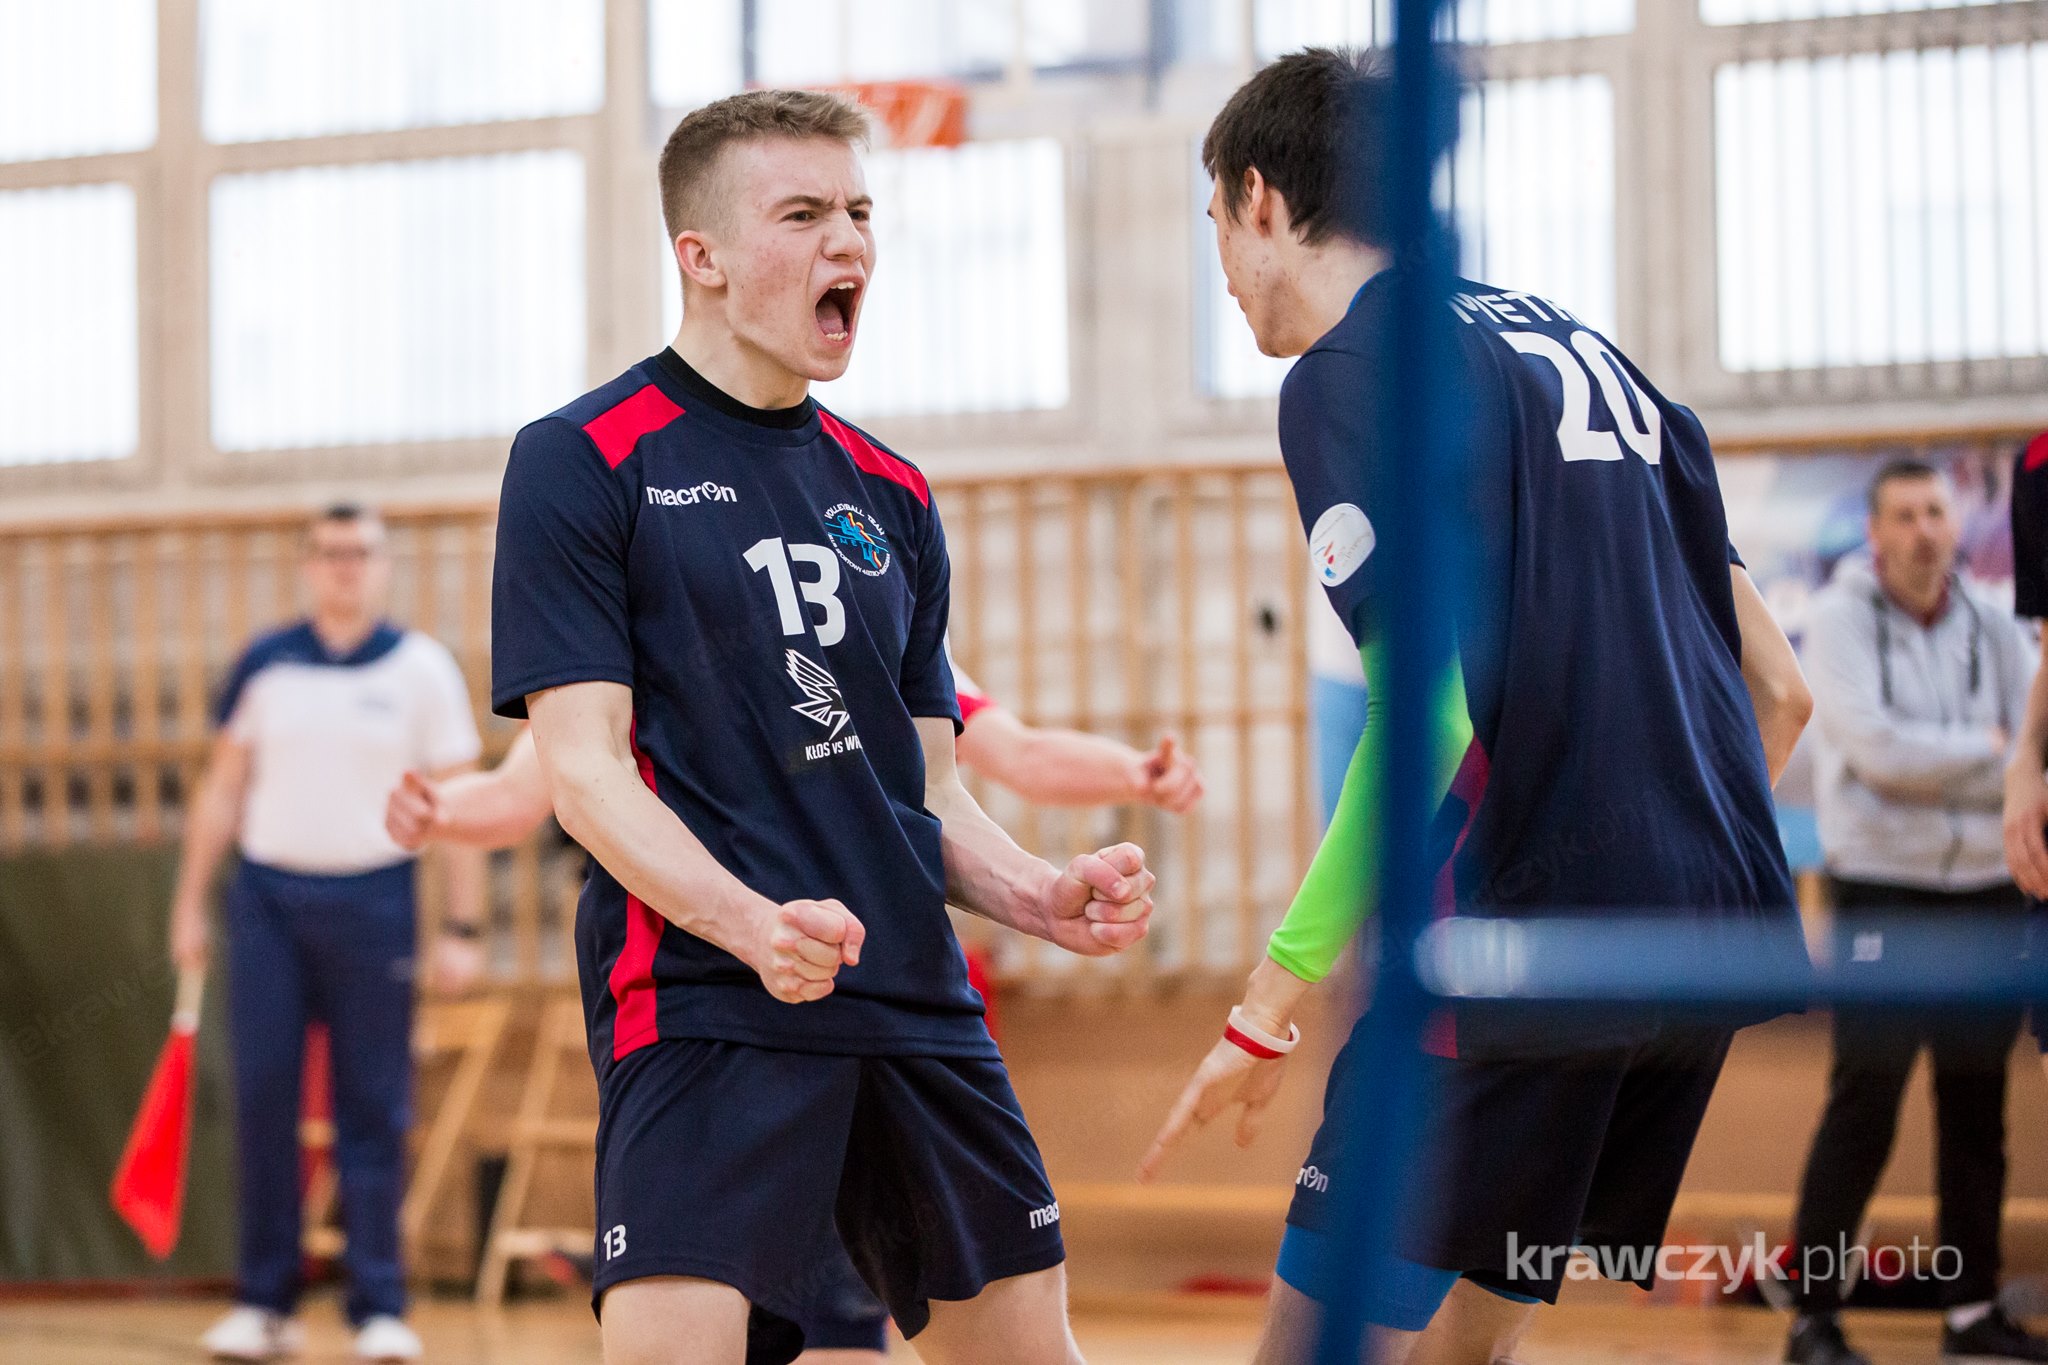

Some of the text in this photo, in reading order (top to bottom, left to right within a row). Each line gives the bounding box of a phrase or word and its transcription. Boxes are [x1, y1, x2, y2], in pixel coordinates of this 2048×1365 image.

[1499, 330, 1661, 465] 20
[646, 481, 738, 506] macron
[742, 537, 846, 647] 13
[602, 1224, 627, 1261] 13
